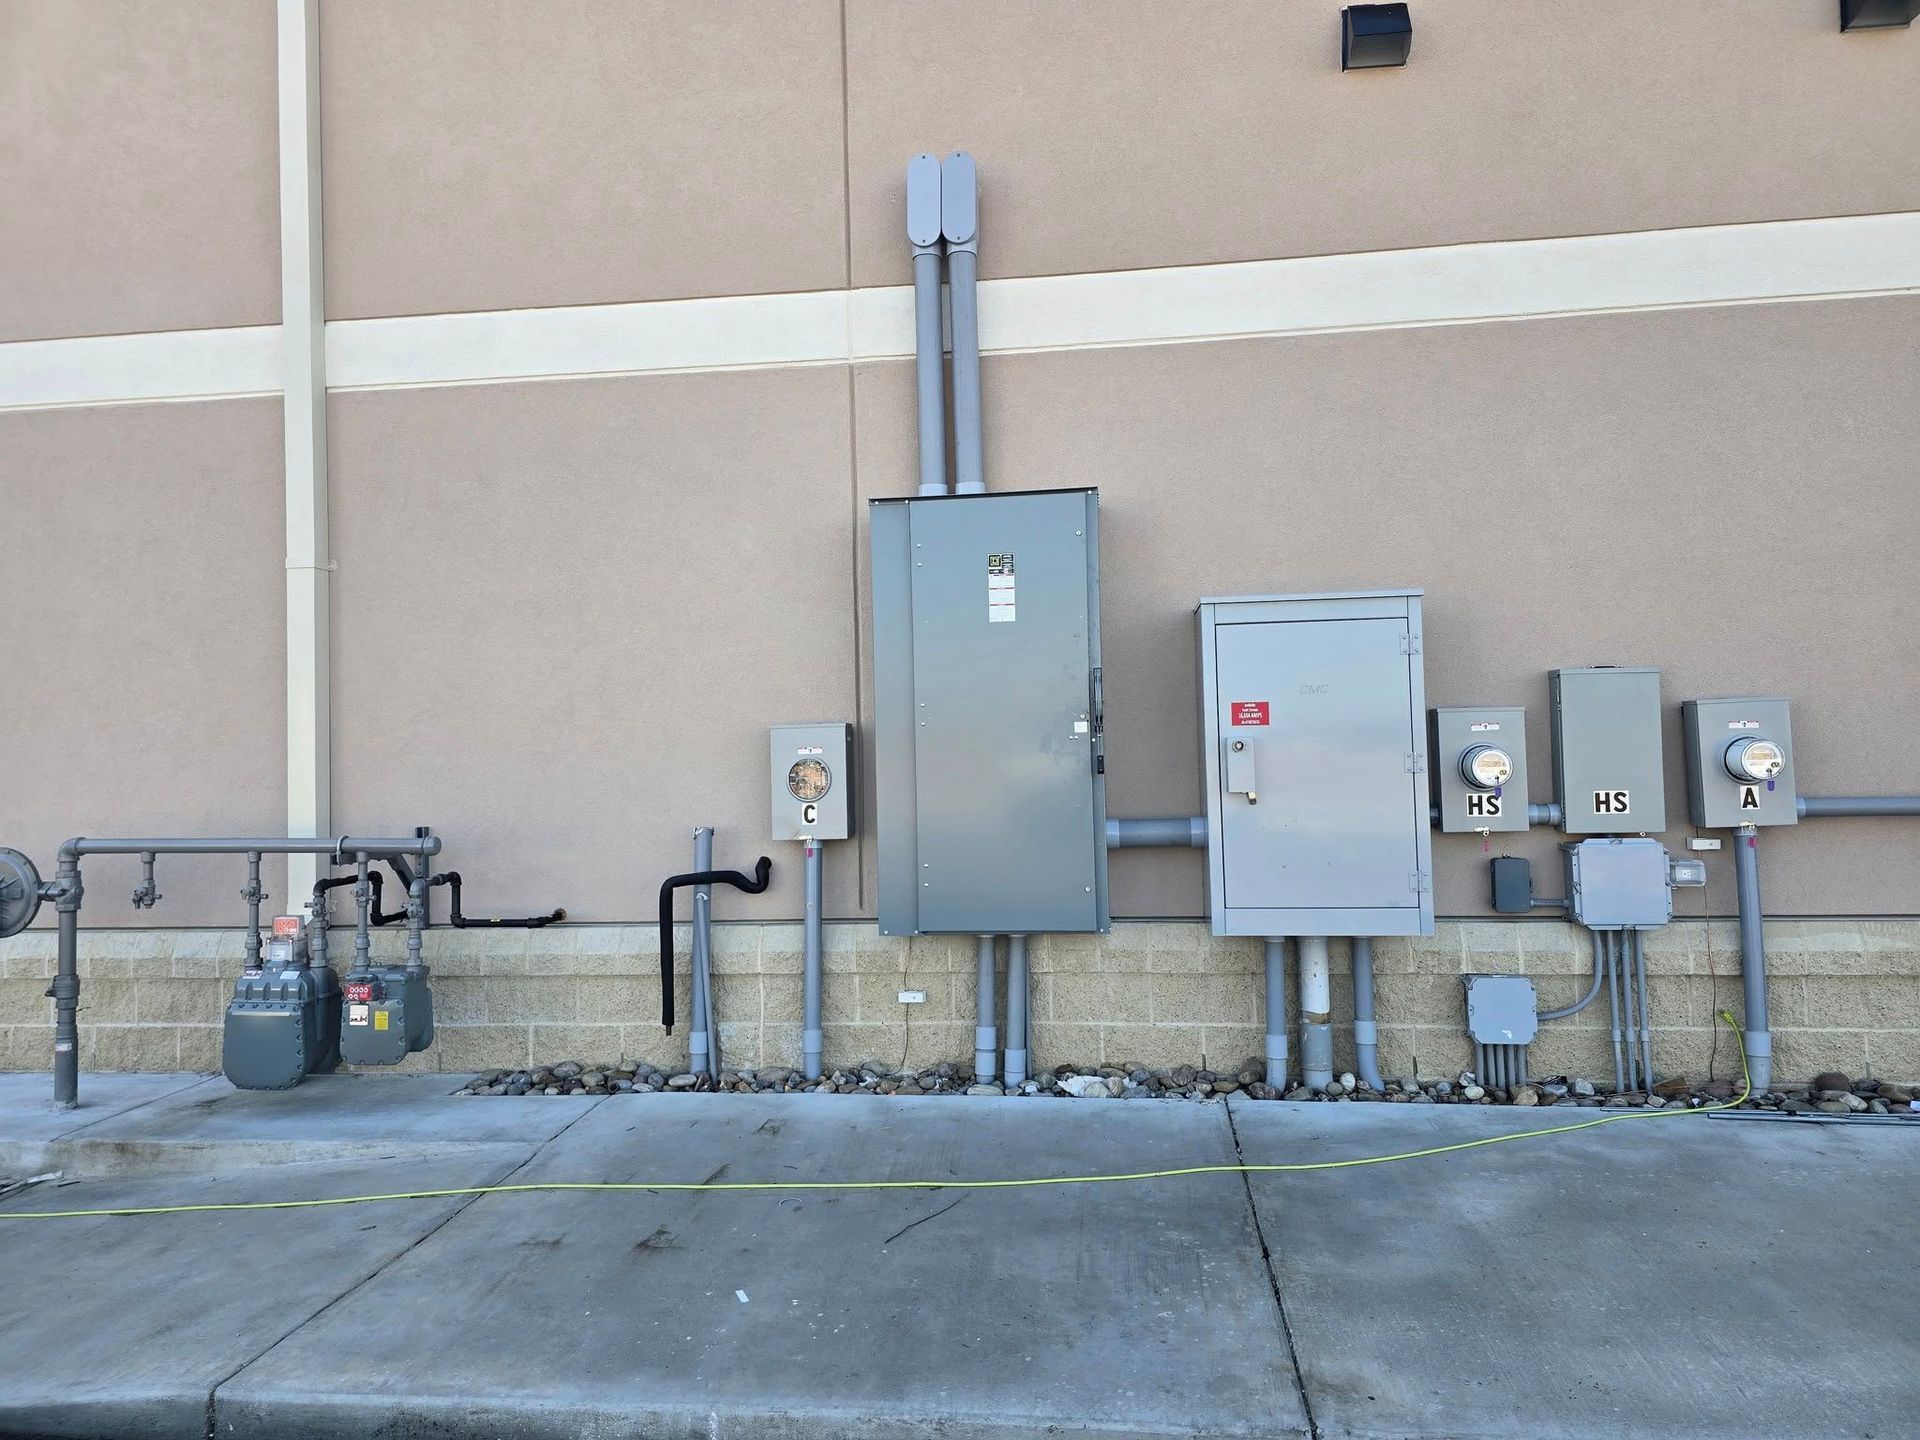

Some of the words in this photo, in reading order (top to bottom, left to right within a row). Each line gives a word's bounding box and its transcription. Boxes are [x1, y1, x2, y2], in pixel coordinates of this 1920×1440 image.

[1299, 683, 1329, 695] CMC
[1468, 795, 1499, 815] HS
[1595, 791, 1627, 812] HS
[1742, 787, 1758, 808] A
[804, 804, 816, 823] C
